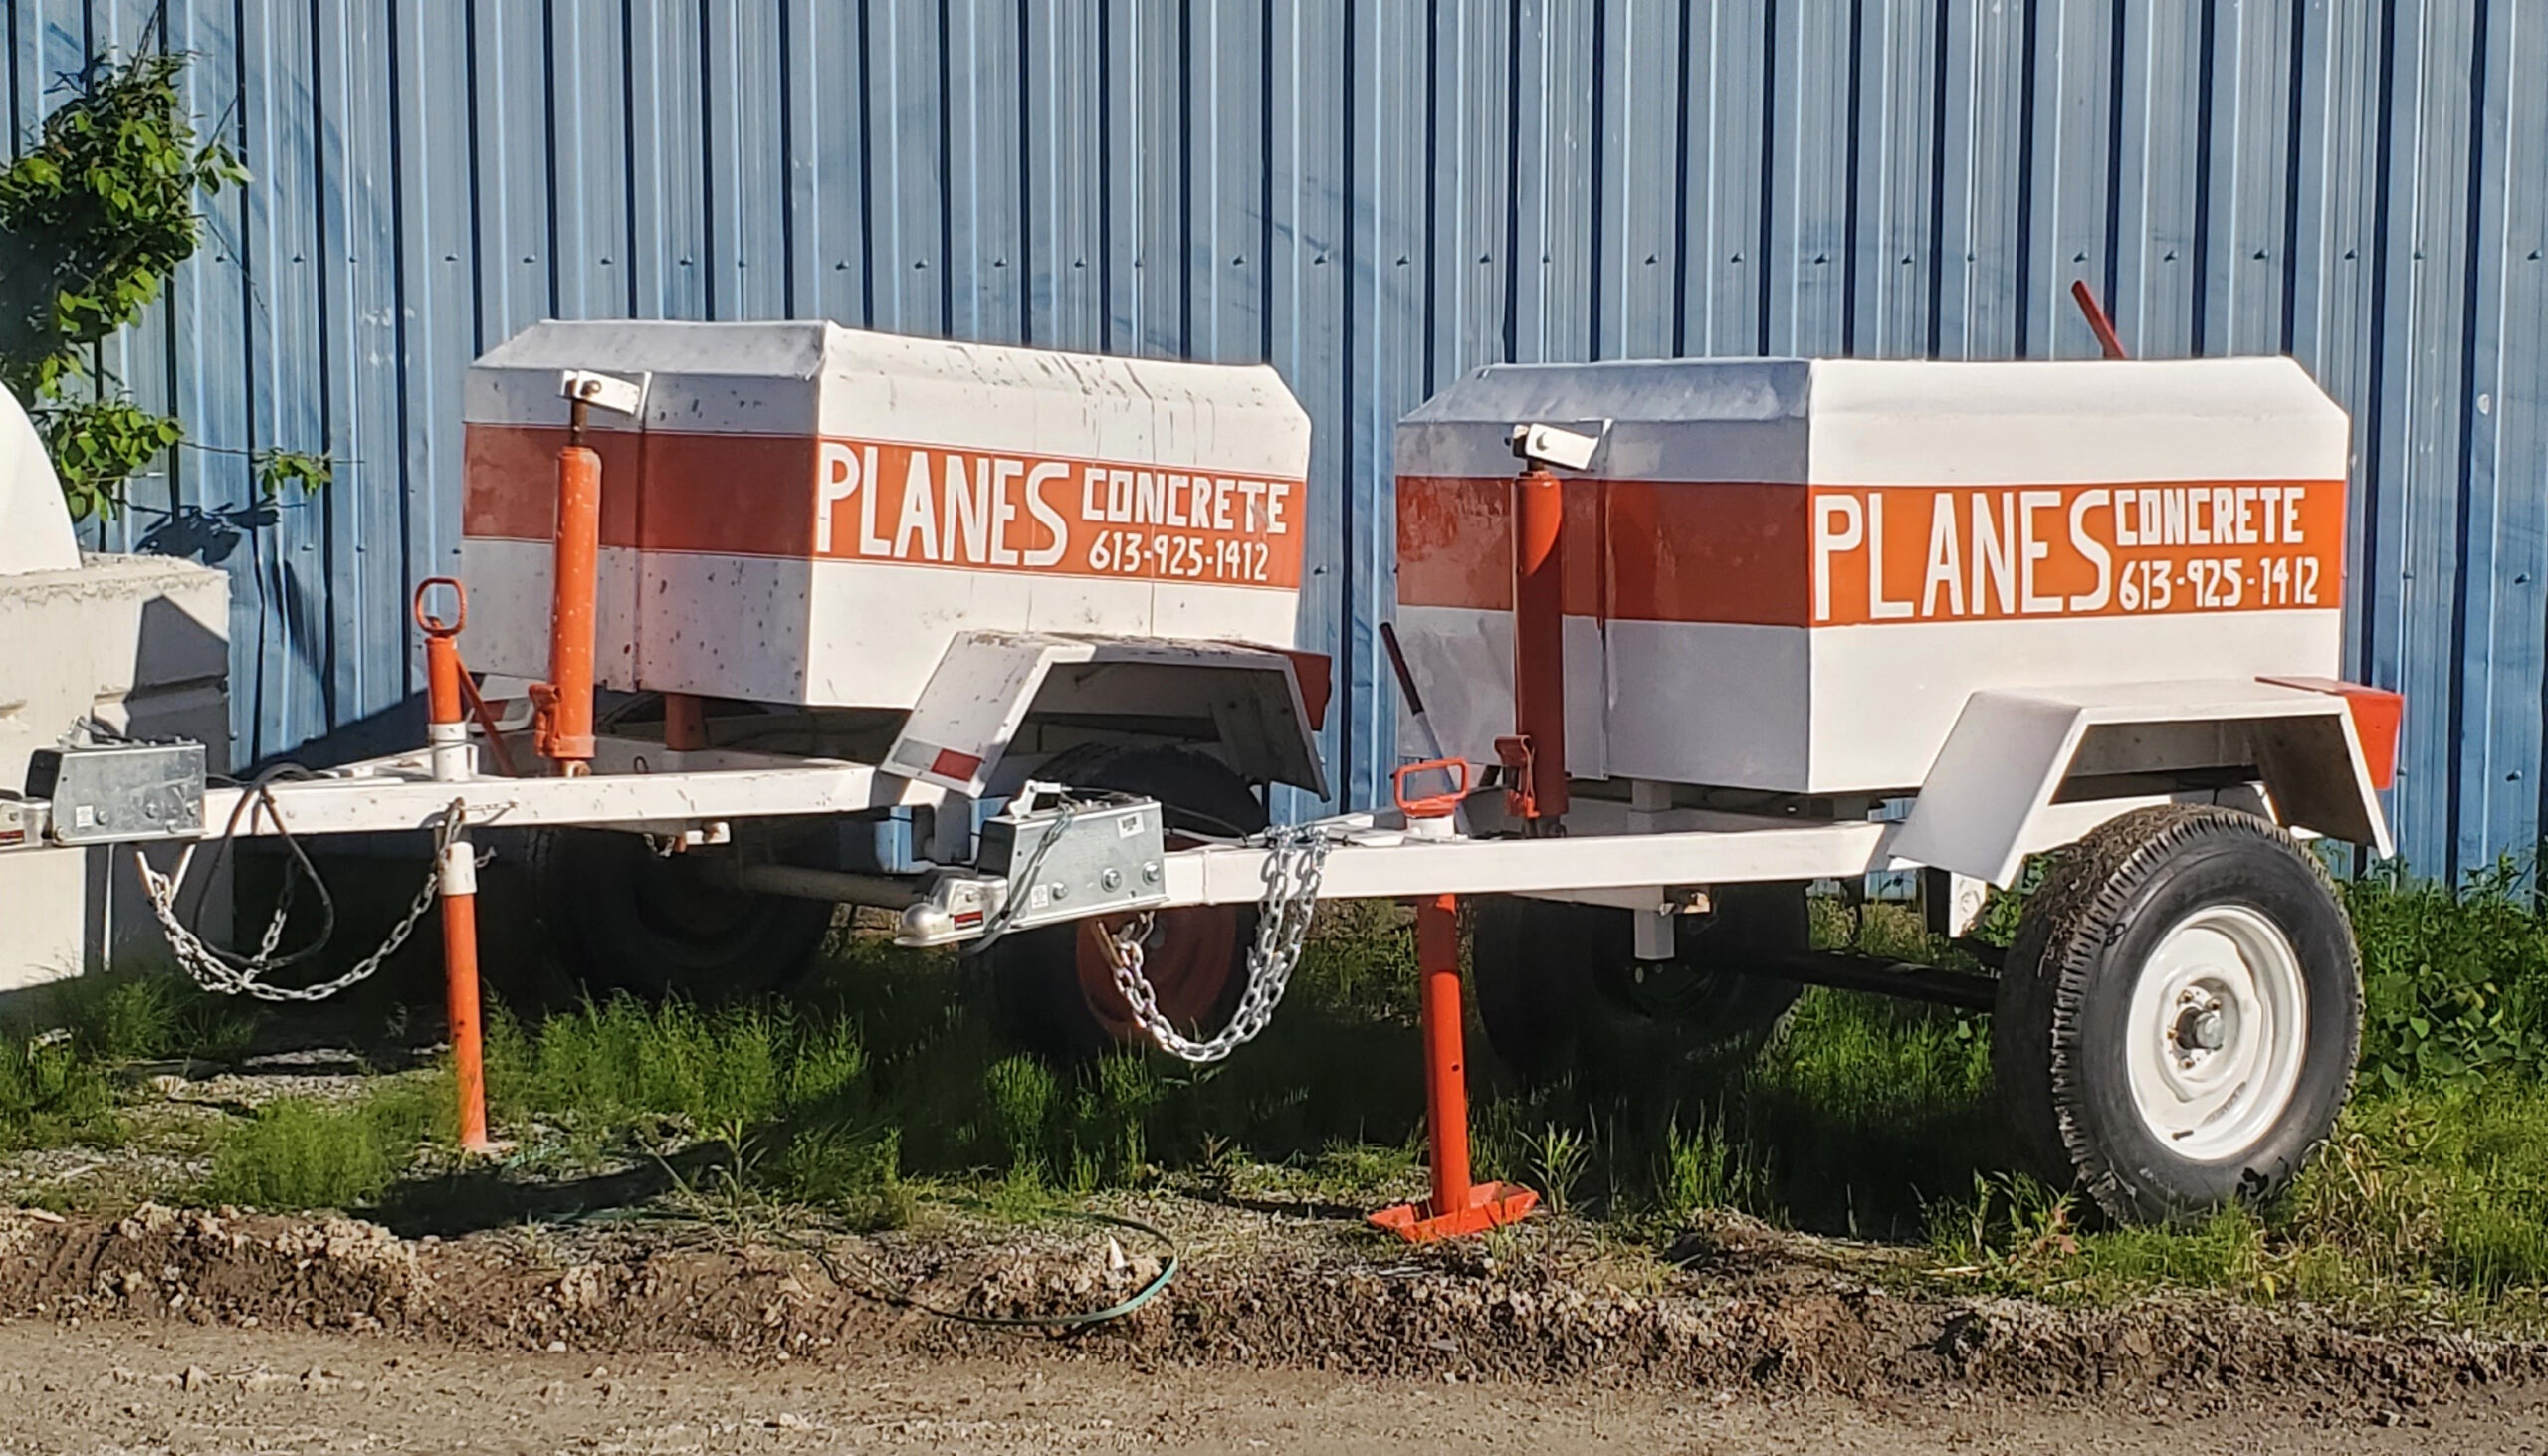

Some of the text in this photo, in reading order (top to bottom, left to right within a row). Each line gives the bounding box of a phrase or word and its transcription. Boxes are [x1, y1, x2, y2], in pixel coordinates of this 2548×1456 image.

[817, 444, 1290, 566] PLANES CONCRETE
[1089, 530, 1269, 581] 613-925-1412
[1814, 487, 2306, 621] PLANES CONCRETE
[2119, 557, 2319, 610] 613-925-1412
